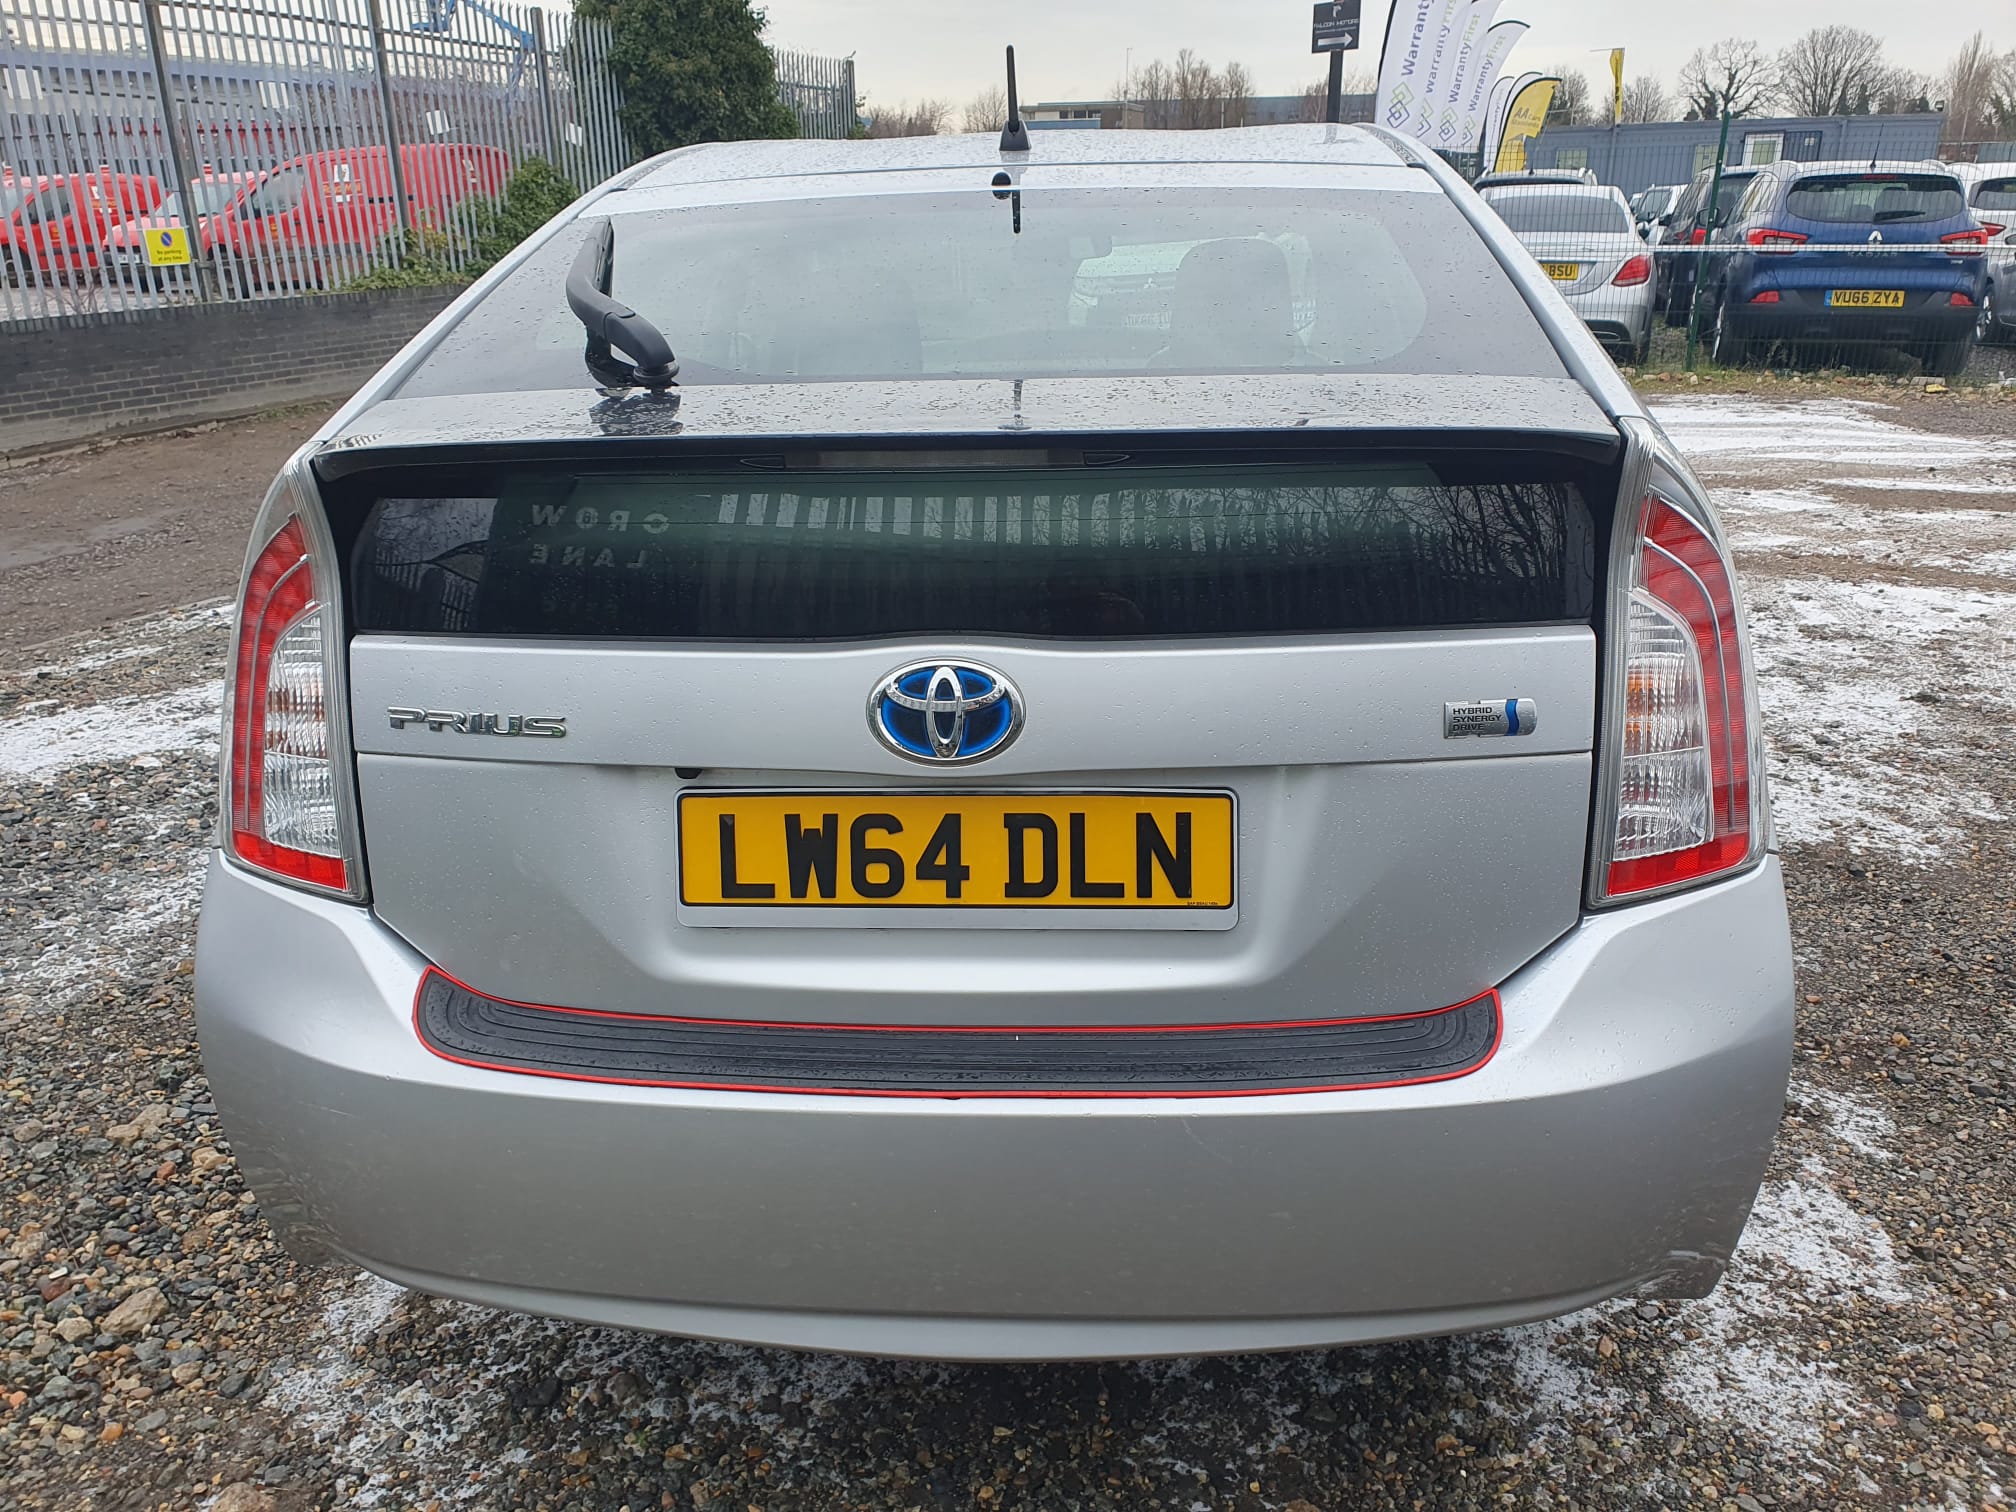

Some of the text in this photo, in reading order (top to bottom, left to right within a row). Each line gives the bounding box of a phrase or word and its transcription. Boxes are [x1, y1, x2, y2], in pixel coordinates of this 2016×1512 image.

[1401, 0, 1435, 76] Warrant
[1448, 14, 1480, 103] WarrantyFirst
[1833, 291, 1900, 304] VU66 ZYA
[386, 704, 567, 739] PRIUS
[1452, 706, 1493, 715] HYBRID
[1452, 714, 1502, 723] SYNERGY
[1452, 723, 1485, 732] DRIVE
[718, 811, 1193, 899] LW64 DLN
